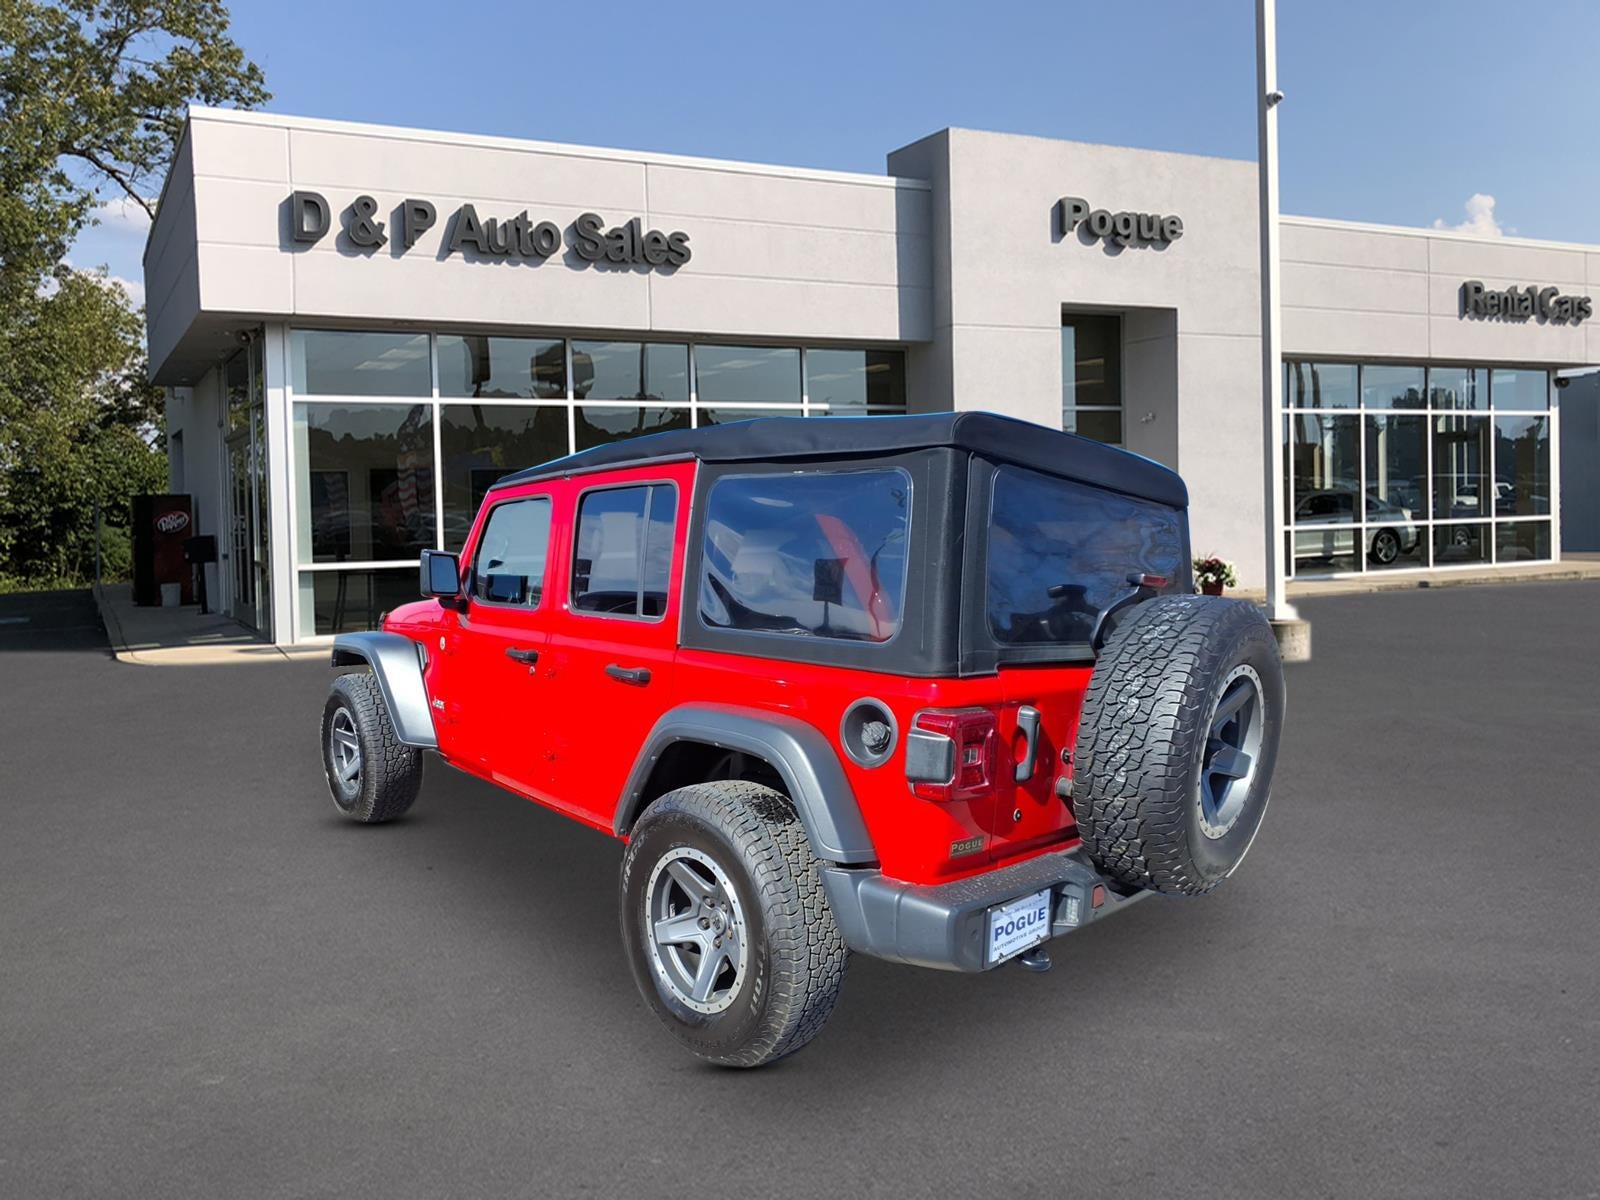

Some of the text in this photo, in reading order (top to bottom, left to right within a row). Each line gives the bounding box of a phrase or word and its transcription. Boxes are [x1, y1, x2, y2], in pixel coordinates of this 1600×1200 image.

[291, 190, 692, 268] D & P Auto Sales
[1060, 196, 1184, 249] Pogue
[1463, 280, 1592, 323] Rental Cars
[994, 906, 1046, 942] POGUE
